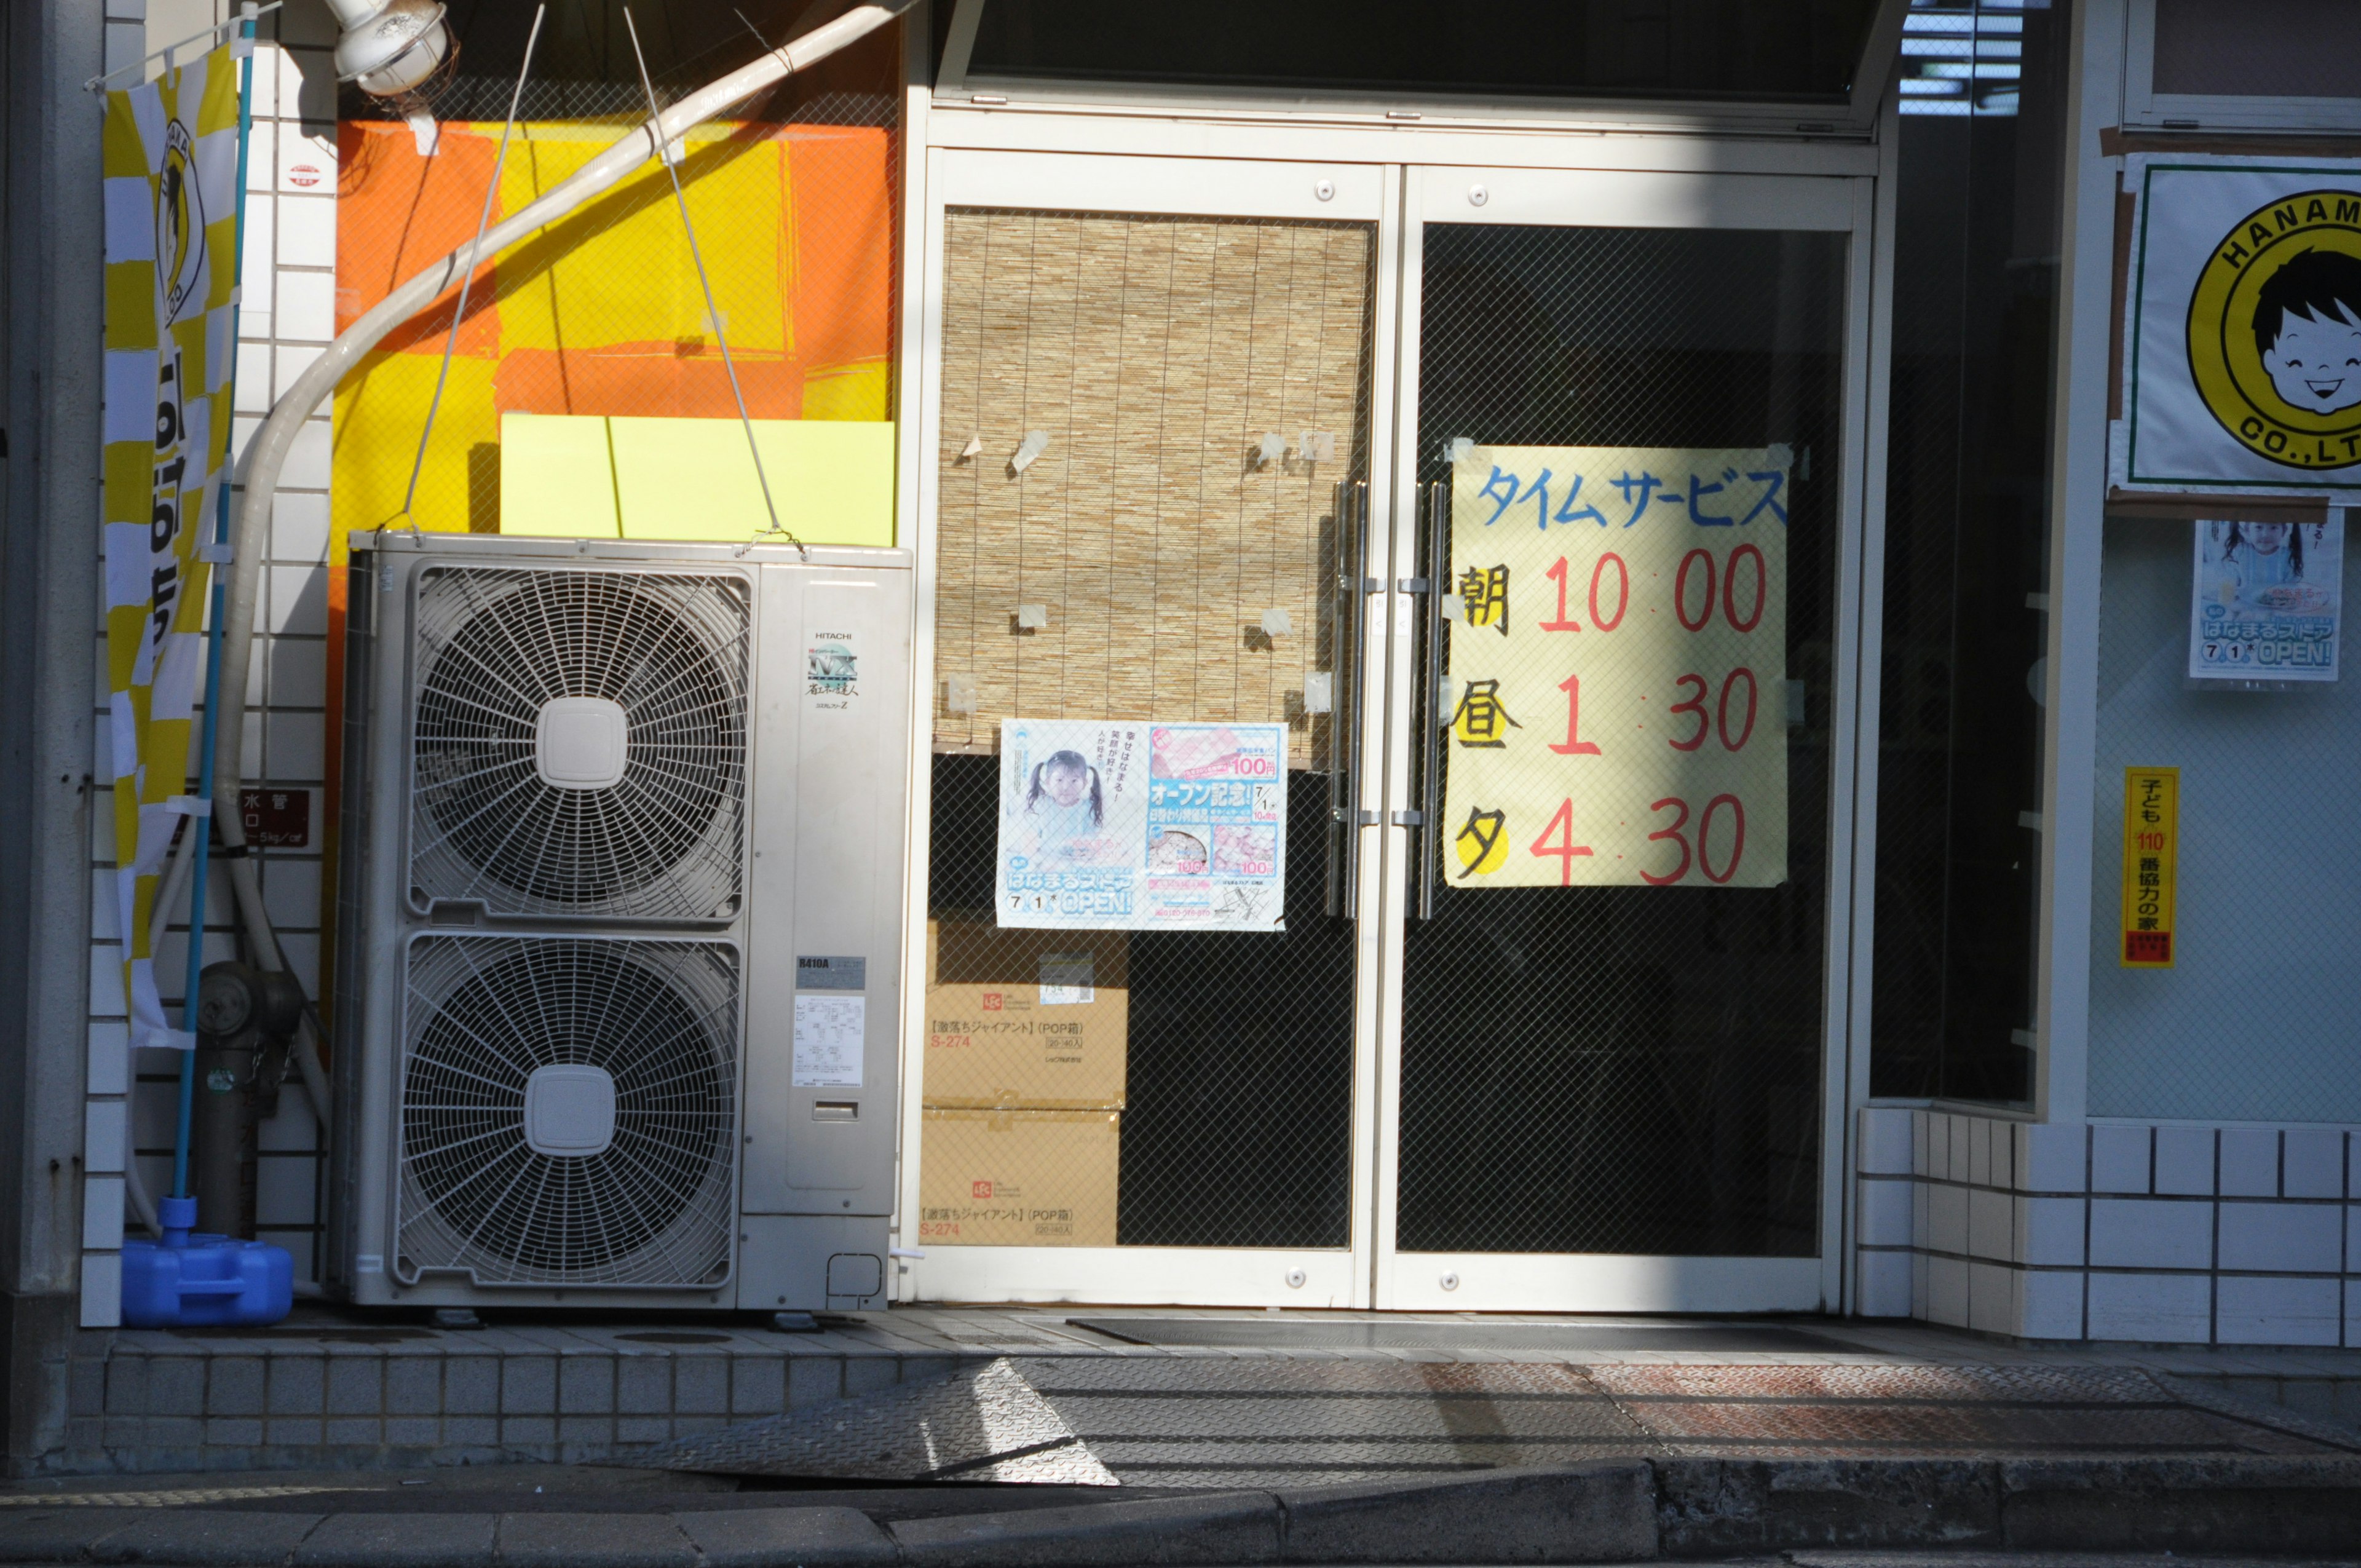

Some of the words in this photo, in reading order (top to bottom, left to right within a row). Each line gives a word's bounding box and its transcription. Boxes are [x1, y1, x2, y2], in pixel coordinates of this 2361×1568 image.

[1477, 465, 1787, 531] タイムサービス
[1458, 563, 1509, 637] 朝
[2203, 620, 2333, 643] はなまるストア
[2258, 640, 2331, 666] OPEN!
[1449, 679, 1522, 748] 昼
[1151, 782, 1251, 807] オープン記念!
[2138, 779, 2165, 930] 子ども110番協力の家
[1241, 861, 1273, 874] 100円
[1006, 872, 1133, 892] はなまるストア
[1062, 892, 1132, 914] OPEN!
[799, 958, 829, 968] R410A
[931, 1035, 970, 1047] S-274
[920, 1223, 960, 1235] S-274
